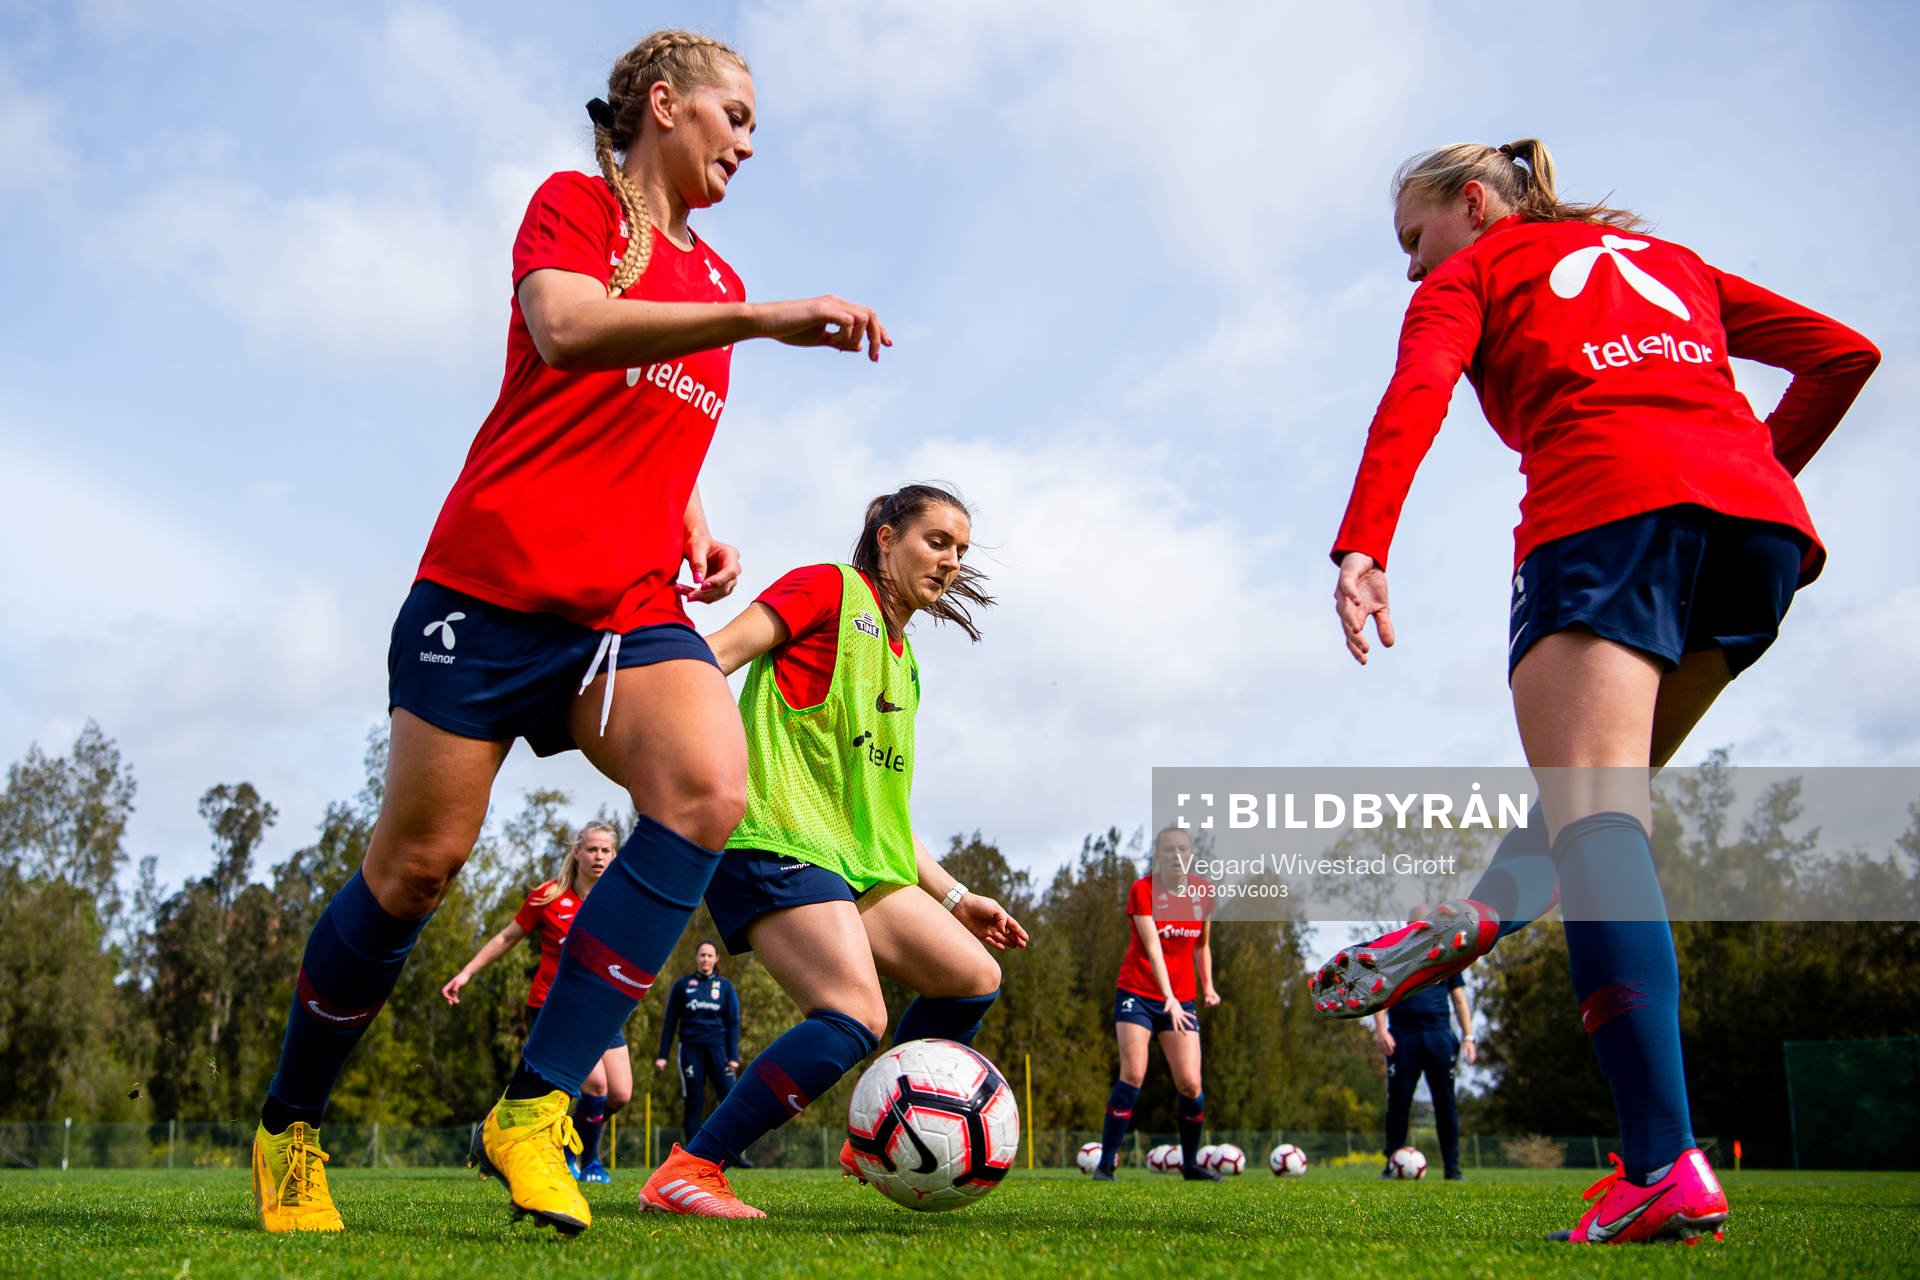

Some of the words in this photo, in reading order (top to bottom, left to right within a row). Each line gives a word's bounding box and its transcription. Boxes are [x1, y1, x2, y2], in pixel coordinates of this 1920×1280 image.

[1582, 333, 1712, 370] telenor
[646, 362, 724, 420] telenor
[419, 651, 456, 665] telenor
